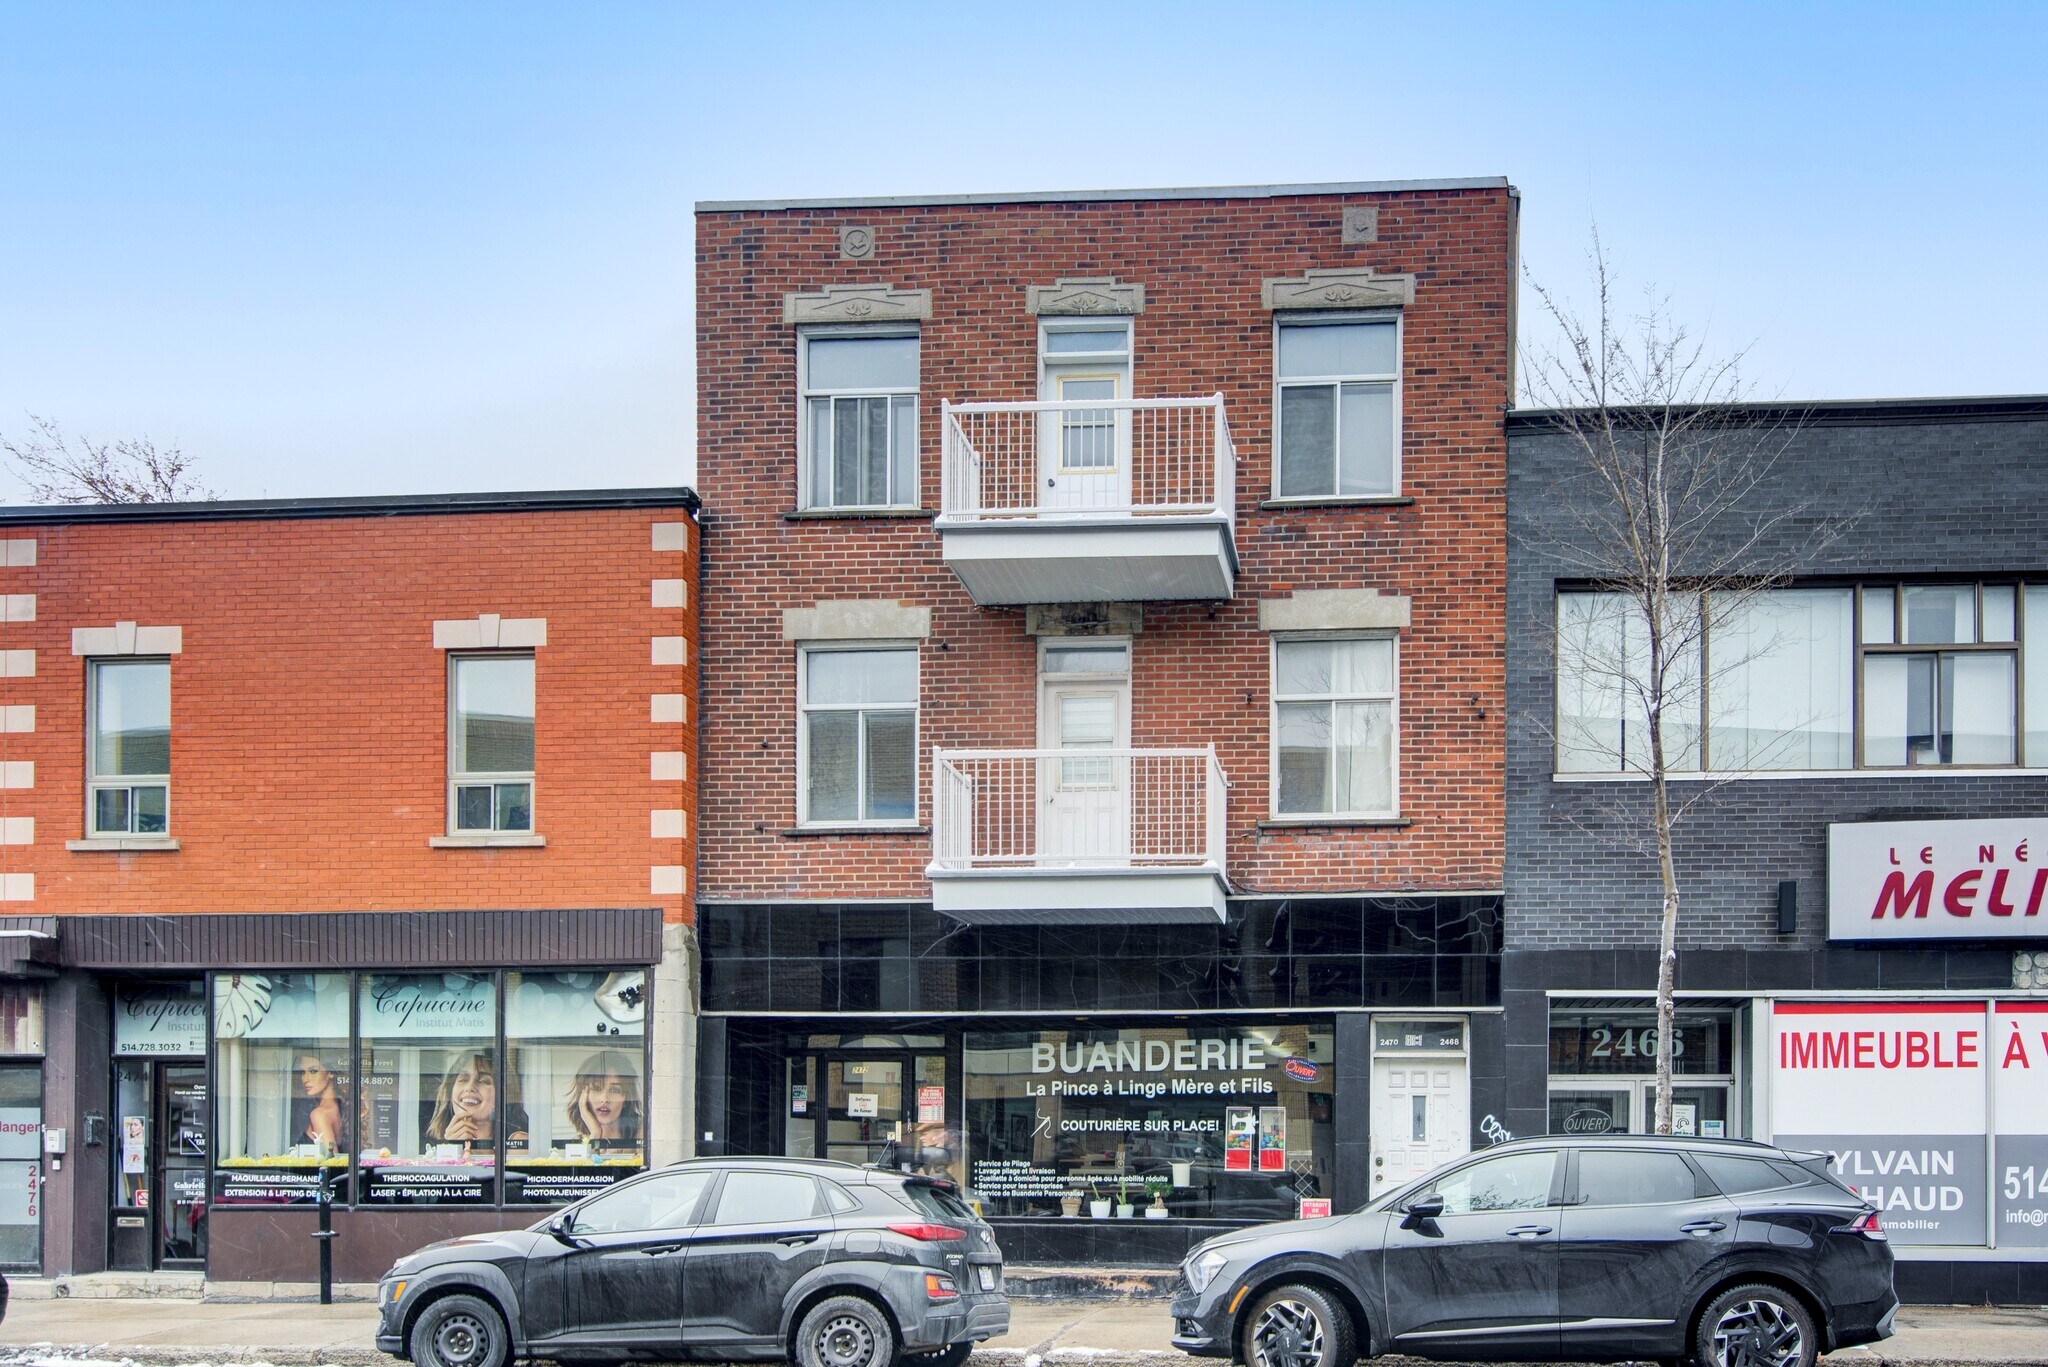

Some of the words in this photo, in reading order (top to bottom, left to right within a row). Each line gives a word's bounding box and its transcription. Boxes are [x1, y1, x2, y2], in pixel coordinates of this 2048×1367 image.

[1890, 846, 1932, 865] LE
[371, 983, 485, 1027] Capucine
[416, 1018, 452, 1027] Institut
[456, 1018, 485, 1027] Matis
[121, 1043, 181, 1052] 514.728.3032
[1780, 1031, 1979, 1069] IMMEUBLE
[2002, 1021, 2030, 1069] À
[1032, 1039, 1267, 1073] BUANDERIE
[1026, 1081, 1046, 1096] La
[1051, 1080, 1098, 1096] Pince
[1103, 1080, 1113, 1096] à
[1119, 1079, 1166, 1098] Linge
[1172, 1078, 1214, 1095] Mère
[1219, 1080, 1236, 1094] et
[1241, 1078, 1273, 1094] Fils
[1061, 1117, 1141, 1131] COUTURIÈRE
[1143, 1119, 1170, 1131] SUR
[1173, 1119, 1219, 1131] PLACE!
[1565, 1117, 1609, 1131] OUVERT
[1811, 1150, 1954, 1175] YLVAIN
[231, 1174, 280, 1183] MAQUILLAGE
[382, 1174, 470, 1182] THERMOCOAGULATION
[526, 1175, 615, 1183] MICRODERMABRASION
[225, 1189, 266, 1197] EXTENSION
[275, 1189, 305, 1197] LIFTING
[306, 1189, 317, 1197] DE
[371, 1189, 396, 1197] LASER
[402, 1188, 442, 1197] ÉPILATION
[444, 1187, 450, 1196] À
[452, 1189, 462, 1197] LA
[463, 1189, 481, 1197] CIRE
[1044, 1190, 1084, 1198] Personnalisé
[1850, 1186, 1964, 1211] HAUD
[1882, 1220, 1940, 1230] mmobilier
